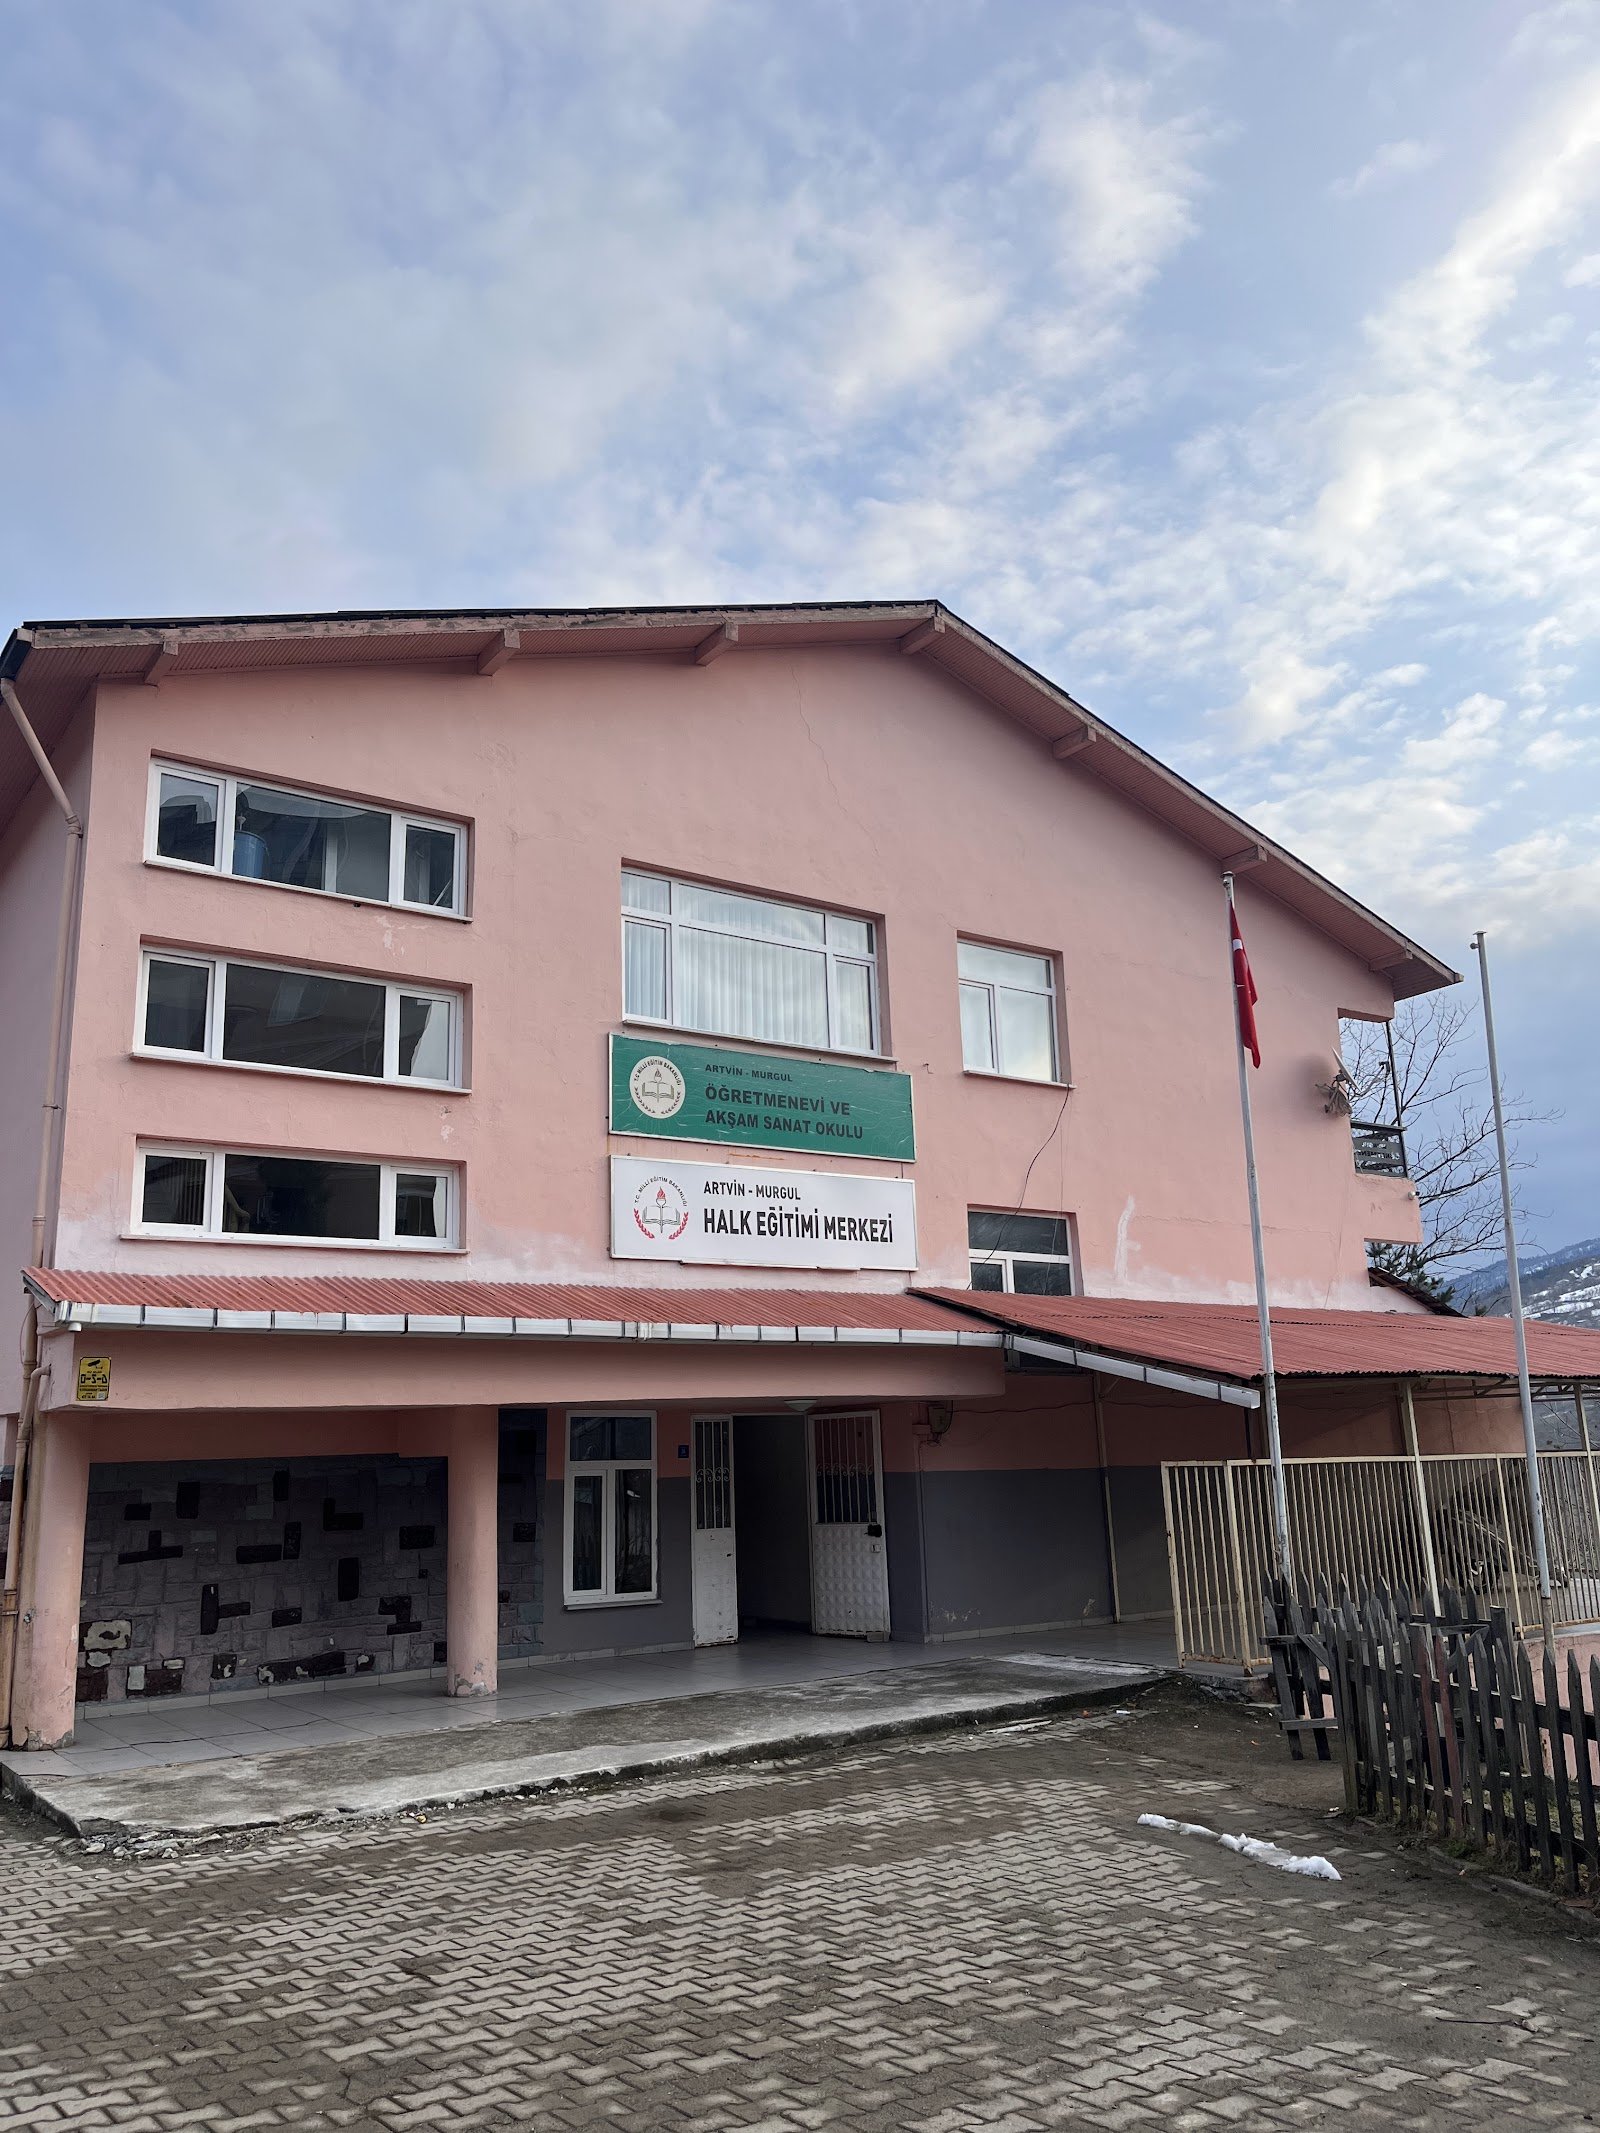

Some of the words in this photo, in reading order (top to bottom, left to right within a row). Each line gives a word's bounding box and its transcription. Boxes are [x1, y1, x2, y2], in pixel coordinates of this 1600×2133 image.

[705, 1063, 743, 1077] ARTVİN
[751, 1070, 793, 1082] MURGUL
[705, 1084, 825, 1113] ÖĞRETMENEVİ
[830, 1100, 850, 1116] VE
[705, 1109, 759, 1129] AKŞAM
[763, 1115, 811, 1133] SANAT
[816, 1121, 863, 1139] OKULU
[703, 1179, 745, 1197] ARTVİN
[756, 1184, 801, 1200] MURGUL
[704, 1208, 752, 1235] HALK
[756, 1206, 820, 1239] EĞİTİMİ
[824, 1213, 893, 1243] MERKEZİ
